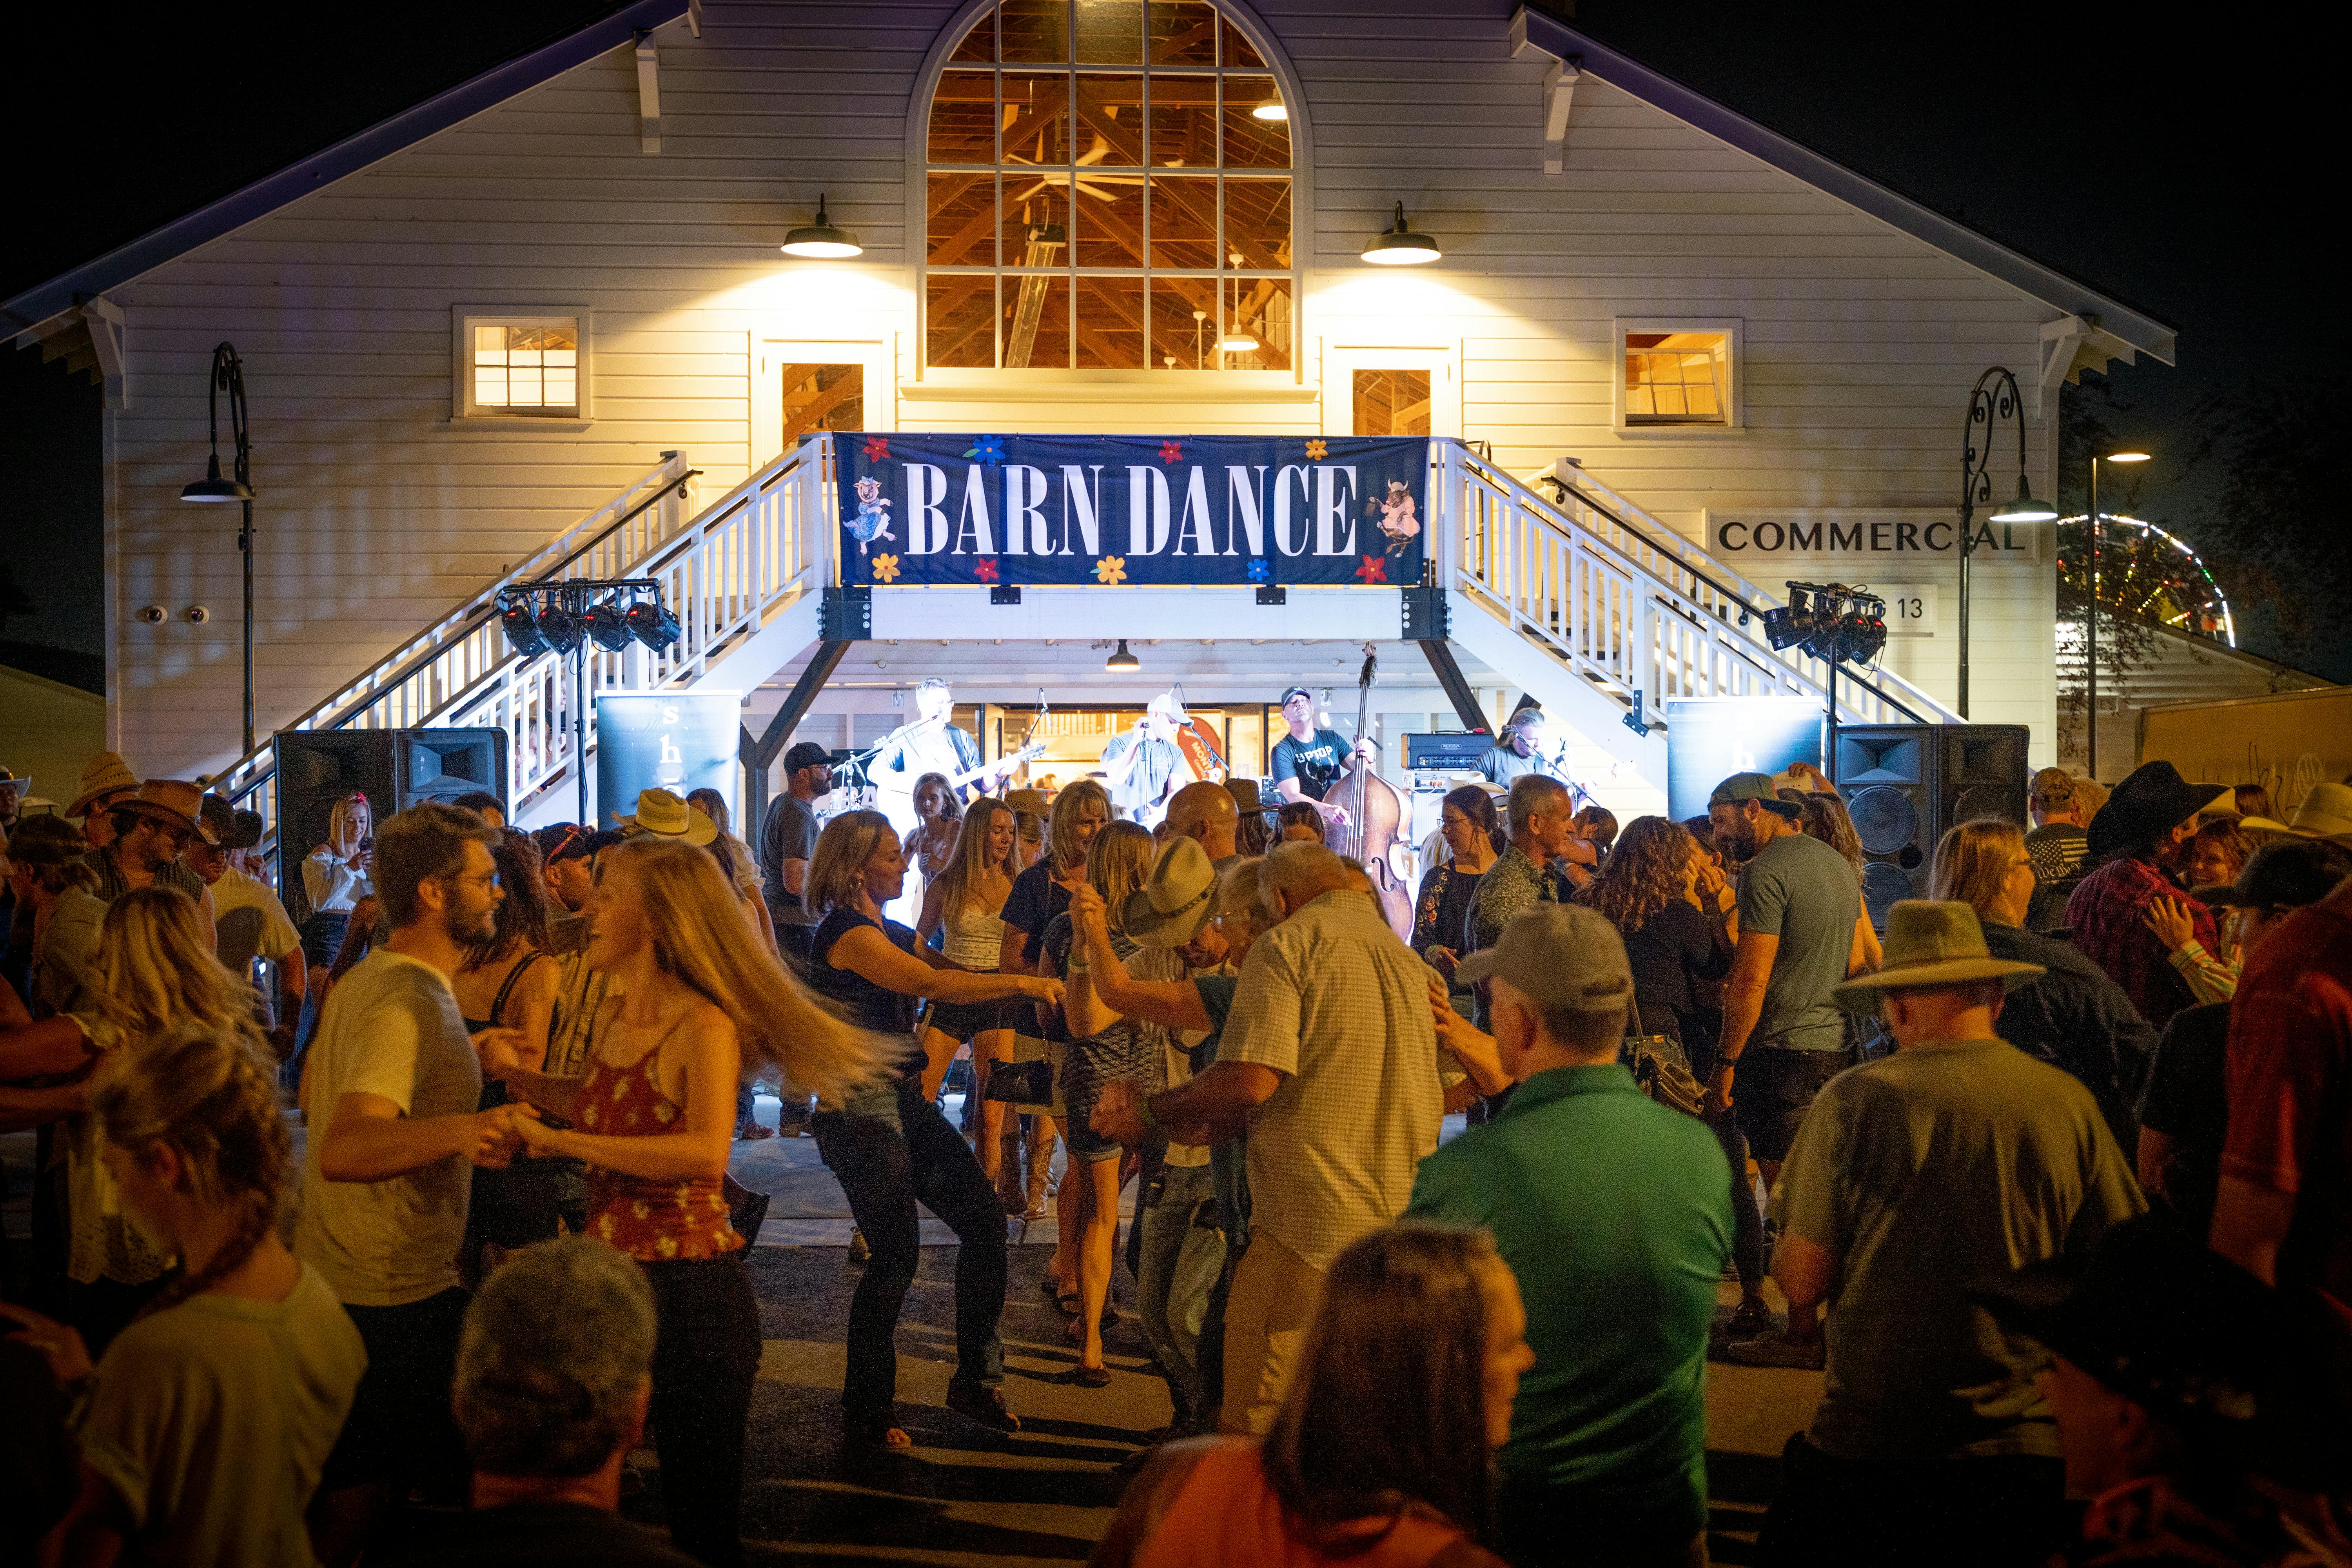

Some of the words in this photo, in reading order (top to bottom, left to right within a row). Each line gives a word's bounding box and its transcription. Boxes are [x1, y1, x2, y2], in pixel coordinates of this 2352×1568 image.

[902, 463, 1104, 556] BARN
[1125, 465, 1356, 557] DANCE
[1719, 521, 2025, 551] COMMERCAL
[1898, 598, 1922, 618] 13
[1295, 746, 1333, 763] UPTOP
[2038, 867, 2055, 879] We
